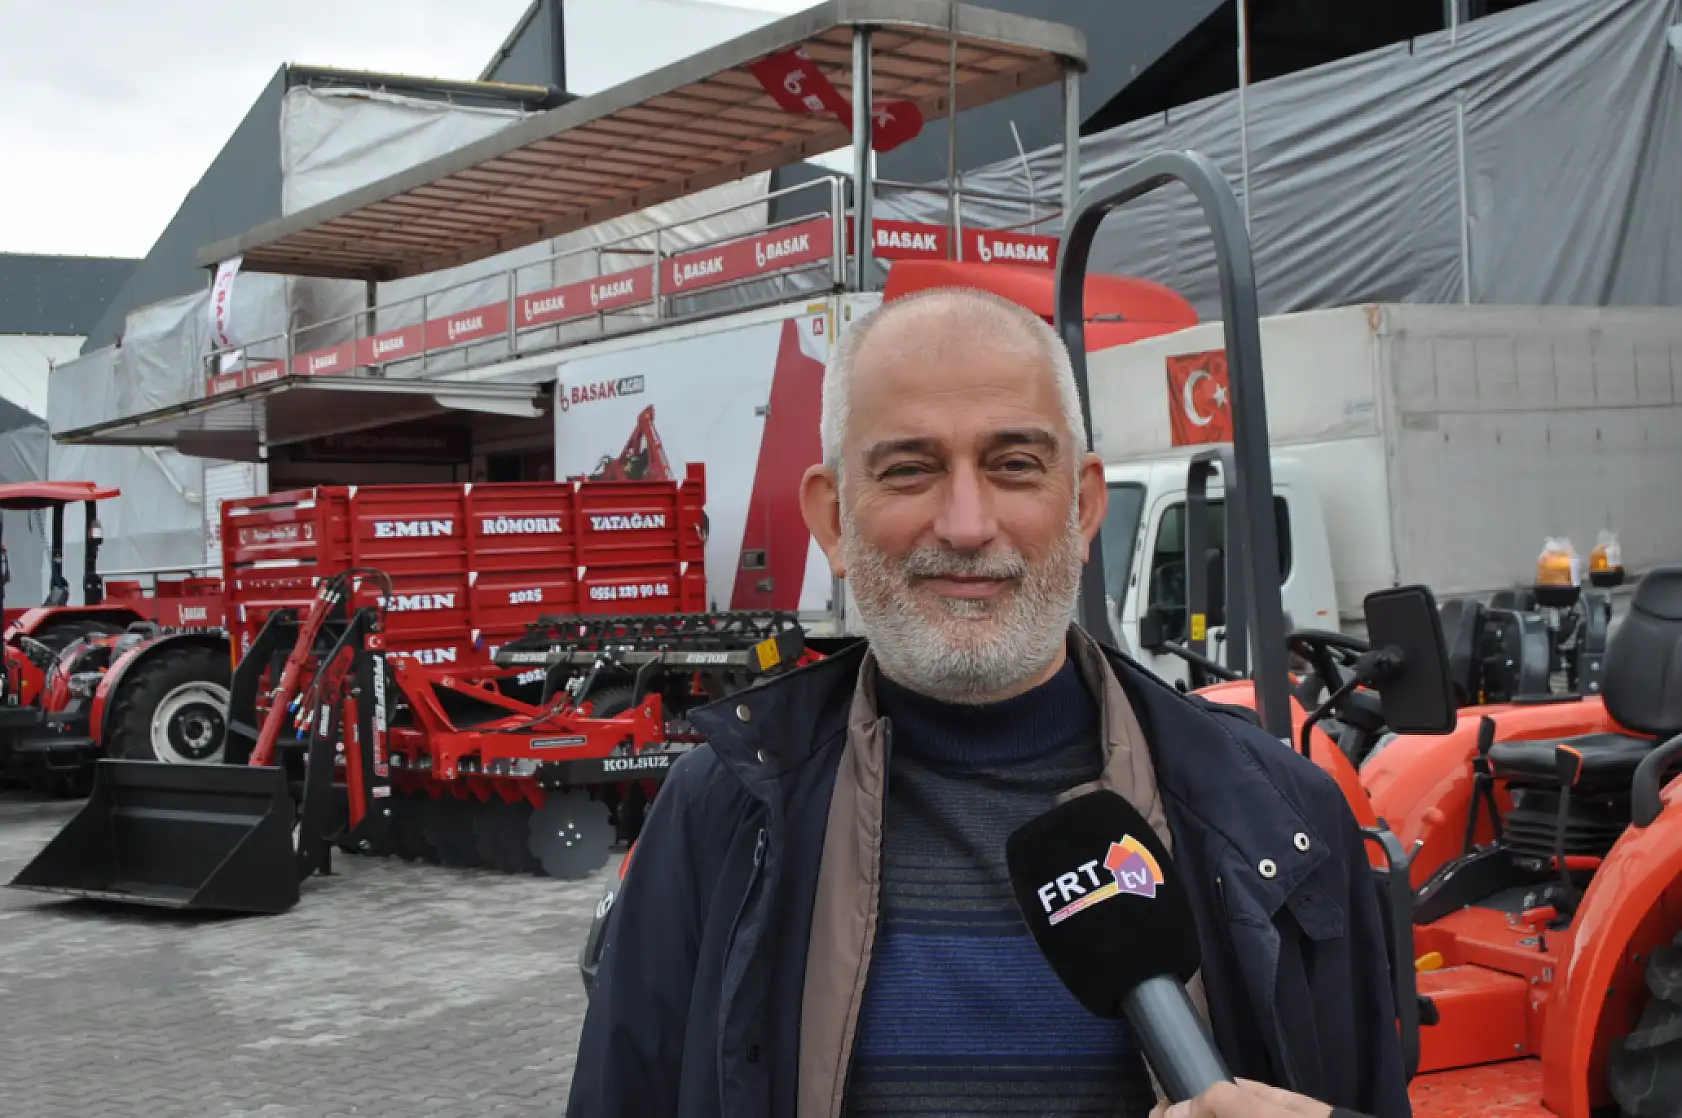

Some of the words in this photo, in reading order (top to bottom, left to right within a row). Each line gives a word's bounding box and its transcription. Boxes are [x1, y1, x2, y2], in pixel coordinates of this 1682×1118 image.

[766, 234, 810, 260] BASAK
[876, 229, 938, 251] BASAK
[993, 240, 1049, 262] BASAK
[683, 256, 723, 280] BASAK
[599, 279, 633, 301] BASAK
[533, 295, 565, 315] BASAK
[571, 380, 617, 404] BASAK
[482, 516, 562, 534] RÖMORK
[590, 512, 666, 531] YATAĞAN
[509, 588, 543, 604] 2025
[603, 755, 669, 772] KOLSUZ
[1037, 859, 1101, 914] FRT
[1120, 867, 1147, 889] tv
